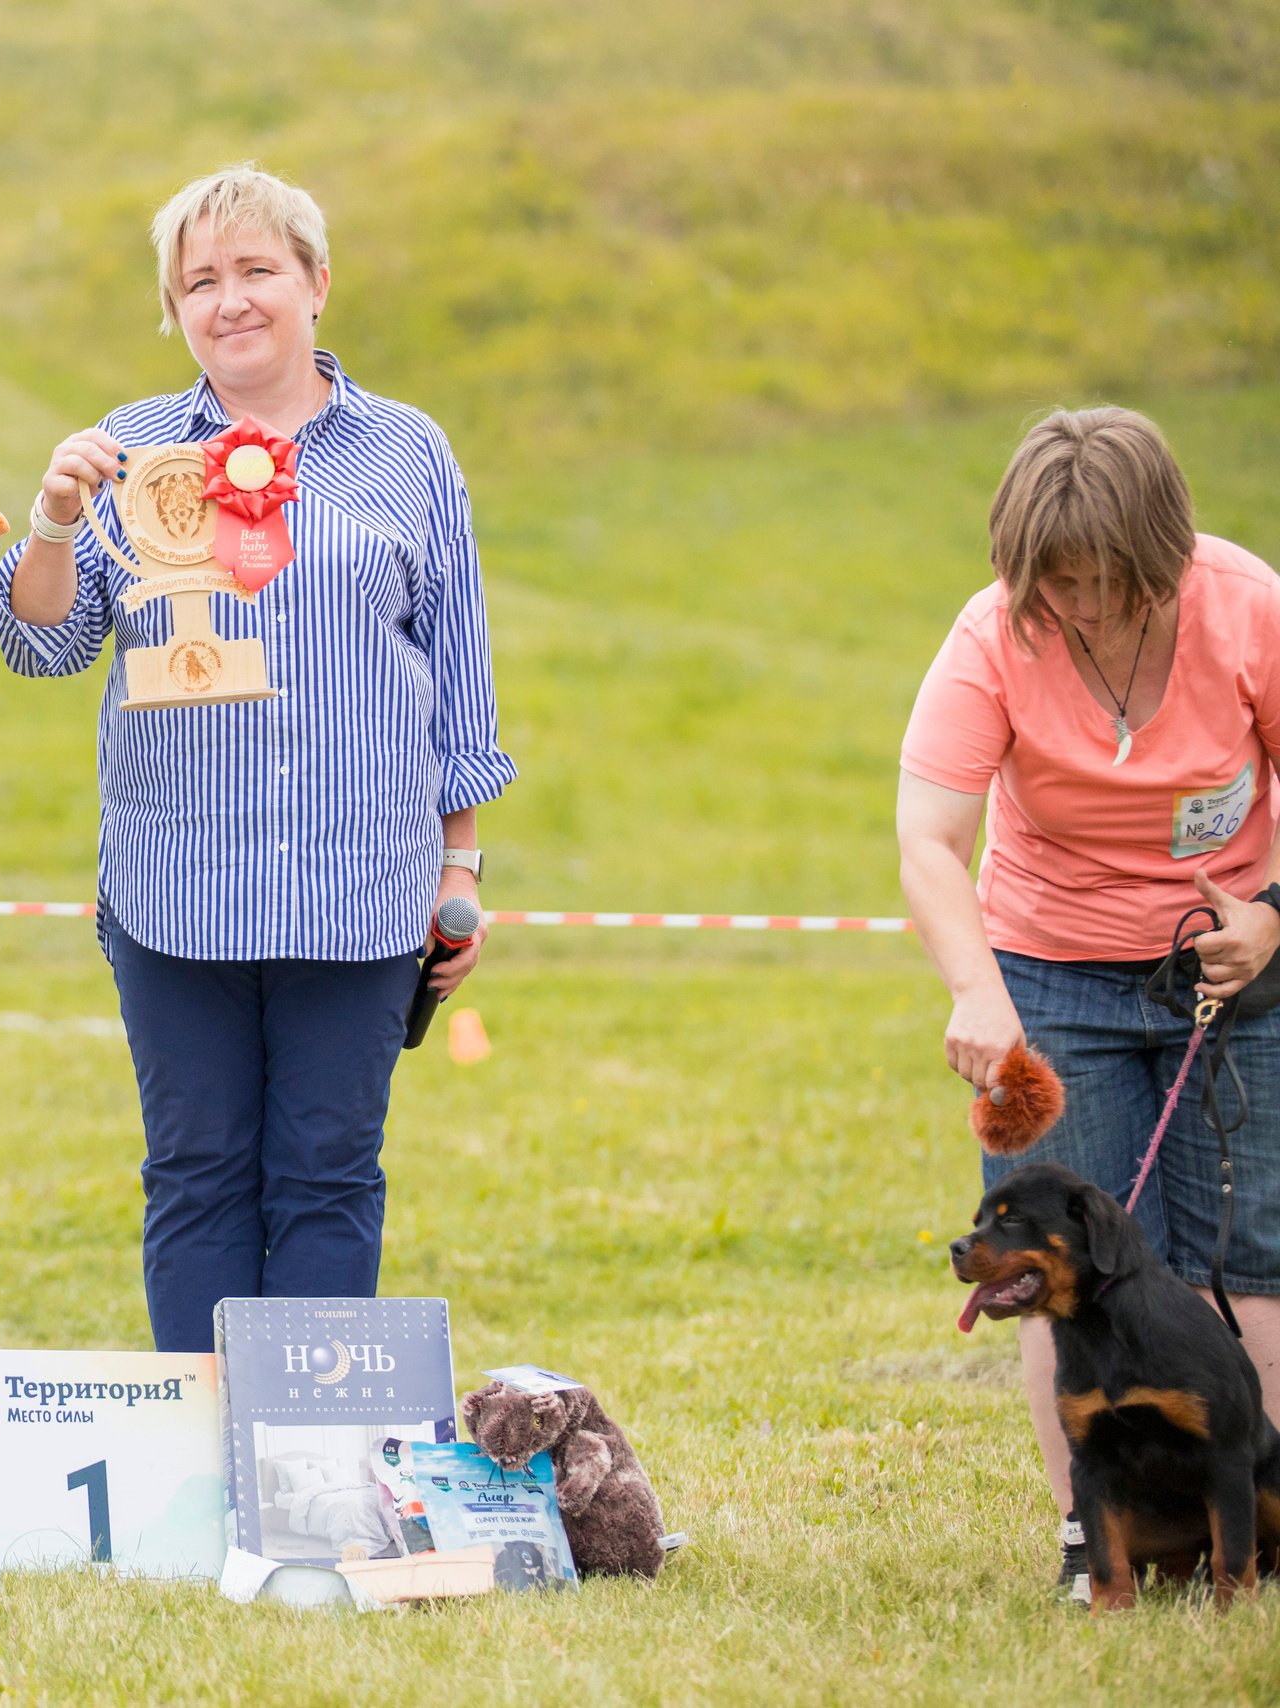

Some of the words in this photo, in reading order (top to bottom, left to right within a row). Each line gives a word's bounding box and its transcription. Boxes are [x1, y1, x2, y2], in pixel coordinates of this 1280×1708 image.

[173, 448, 206, 461] Чемпио
[240, 529, 266, 541] Best
[240, 541, 269, 554] baby
[168, 550, 205, 562] Рязани
[250, 552, 273, 562] кубок
[138, 576, 201, 597] Победитель
[203, 576, 240, 590] Класса
[1197, 802, 1244, 842] 26
[288, 1386, 396, 1399] нежна
[401, 1405, 436, 1413] белья
[66, 1459, 113, 1564] 1
